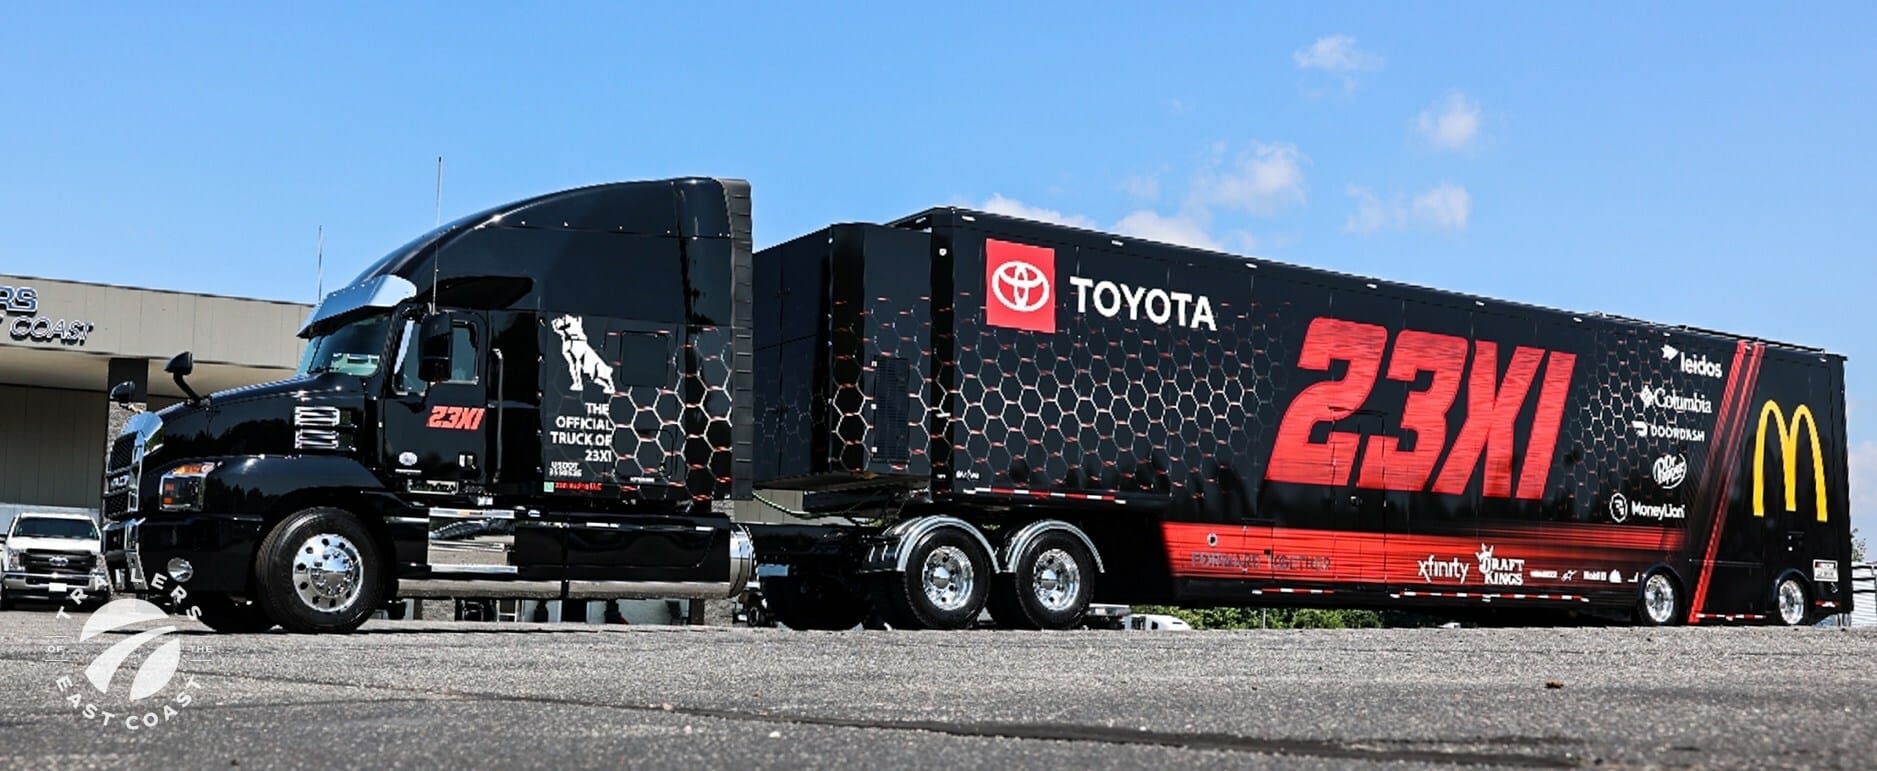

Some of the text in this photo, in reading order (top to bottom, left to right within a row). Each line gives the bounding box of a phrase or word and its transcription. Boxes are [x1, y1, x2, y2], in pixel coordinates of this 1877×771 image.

[1069, 275, 1218, 332] TOYOTA
[10, 316, 94, 340] COAST
[1680, 351, 1723, 379] leidos
[585, 402, 609, 415] THE
[1264, 316, 1578, 501] 23XI
[1653, 387, 1713, 413] Columbia
[426, 405, 485, 430] 23XI
[555, 415, 613, 431] OFFICIAL
[549, 431, 613, 447] TRUCK OF
[1650, 425, 1705, 442] DOORDASH
[584, 449, 612, 462] 23XI
[1631, 500, 1685, 520] MoneyLion
[1417, 554, 1470, 584] xfinity
[1479, 556, 1525, 574] DRAFT
[1484, 571, 1524, 586] KINGS
